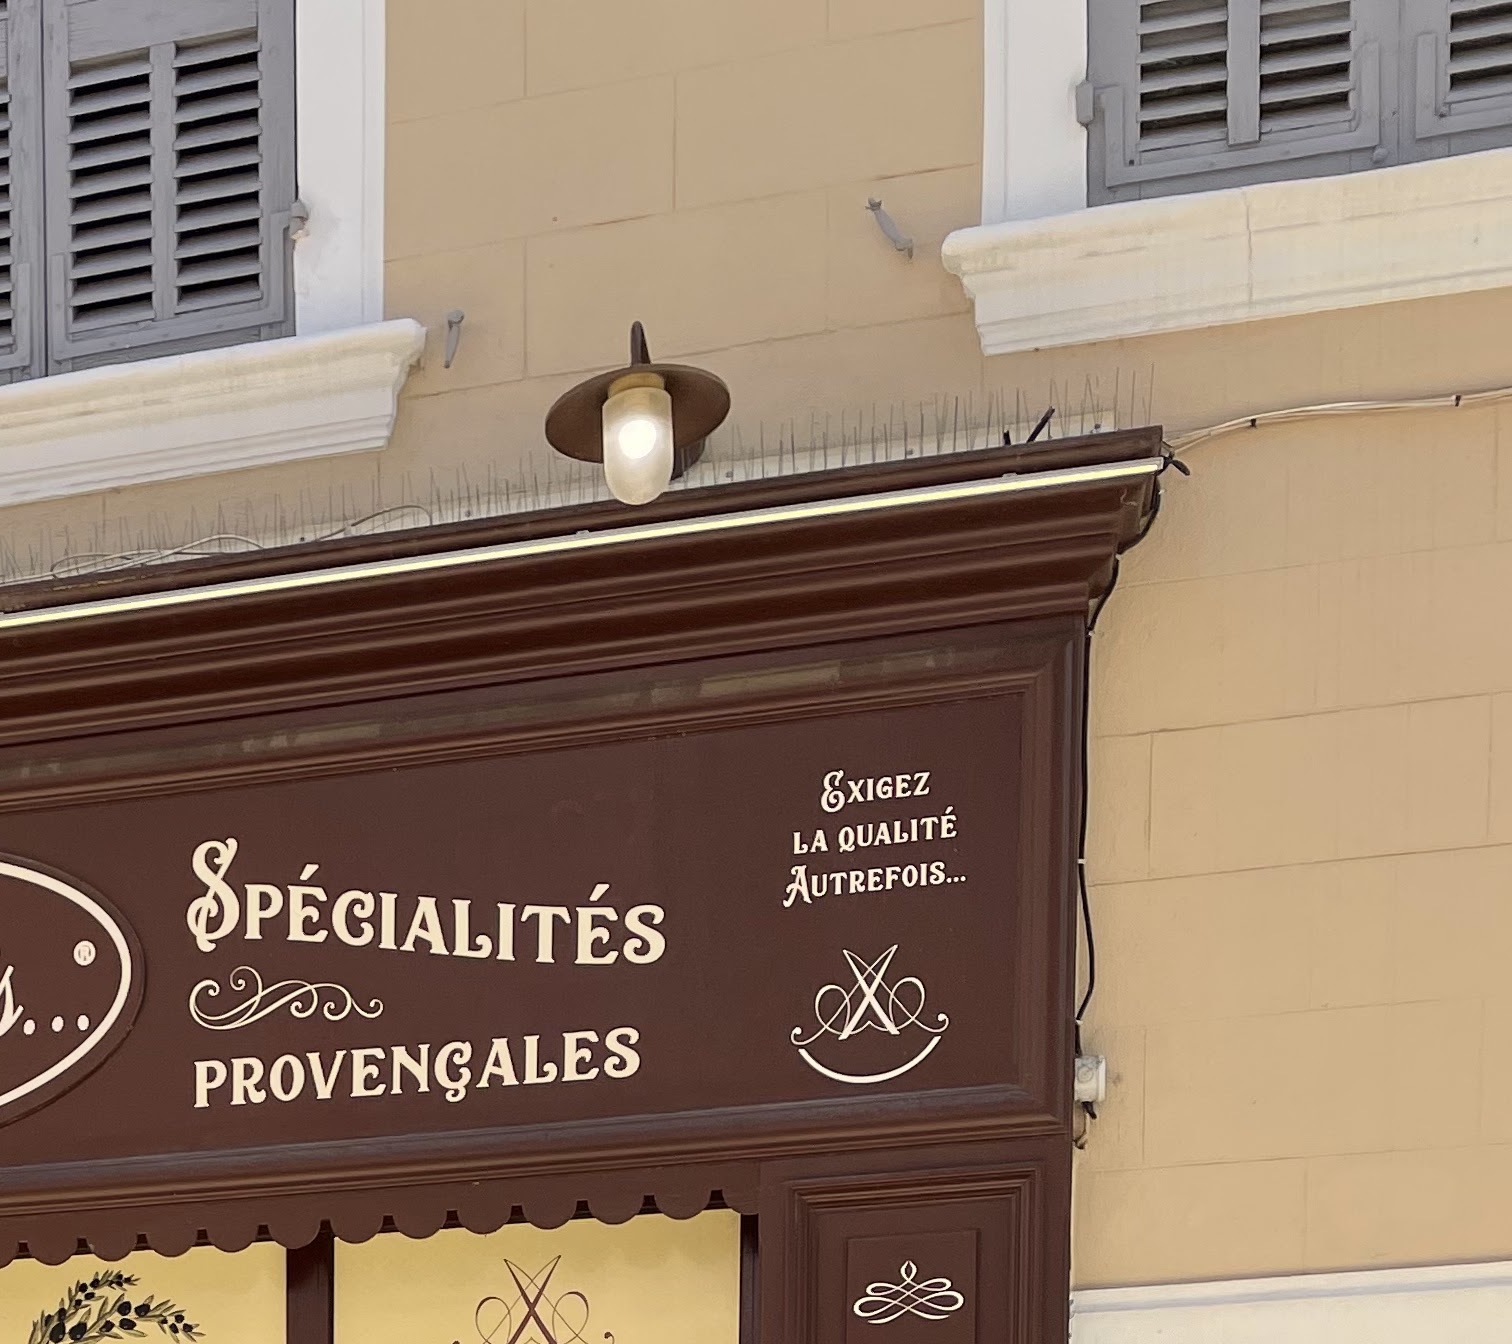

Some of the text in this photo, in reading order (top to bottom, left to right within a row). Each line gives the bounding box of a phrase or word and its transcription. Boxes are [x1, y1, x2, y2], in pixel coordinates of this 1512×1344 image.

[820, 769, 931, 813] EXIGEZ
[793, 806, 957, 855] LA QUALITÉ
[186, 837, 666, 965] SPÉCIALITÉS
[782, 861, 966, 908] AUTREFOIS...
[193, 1026, 641, 1108] PROVENÇALES
